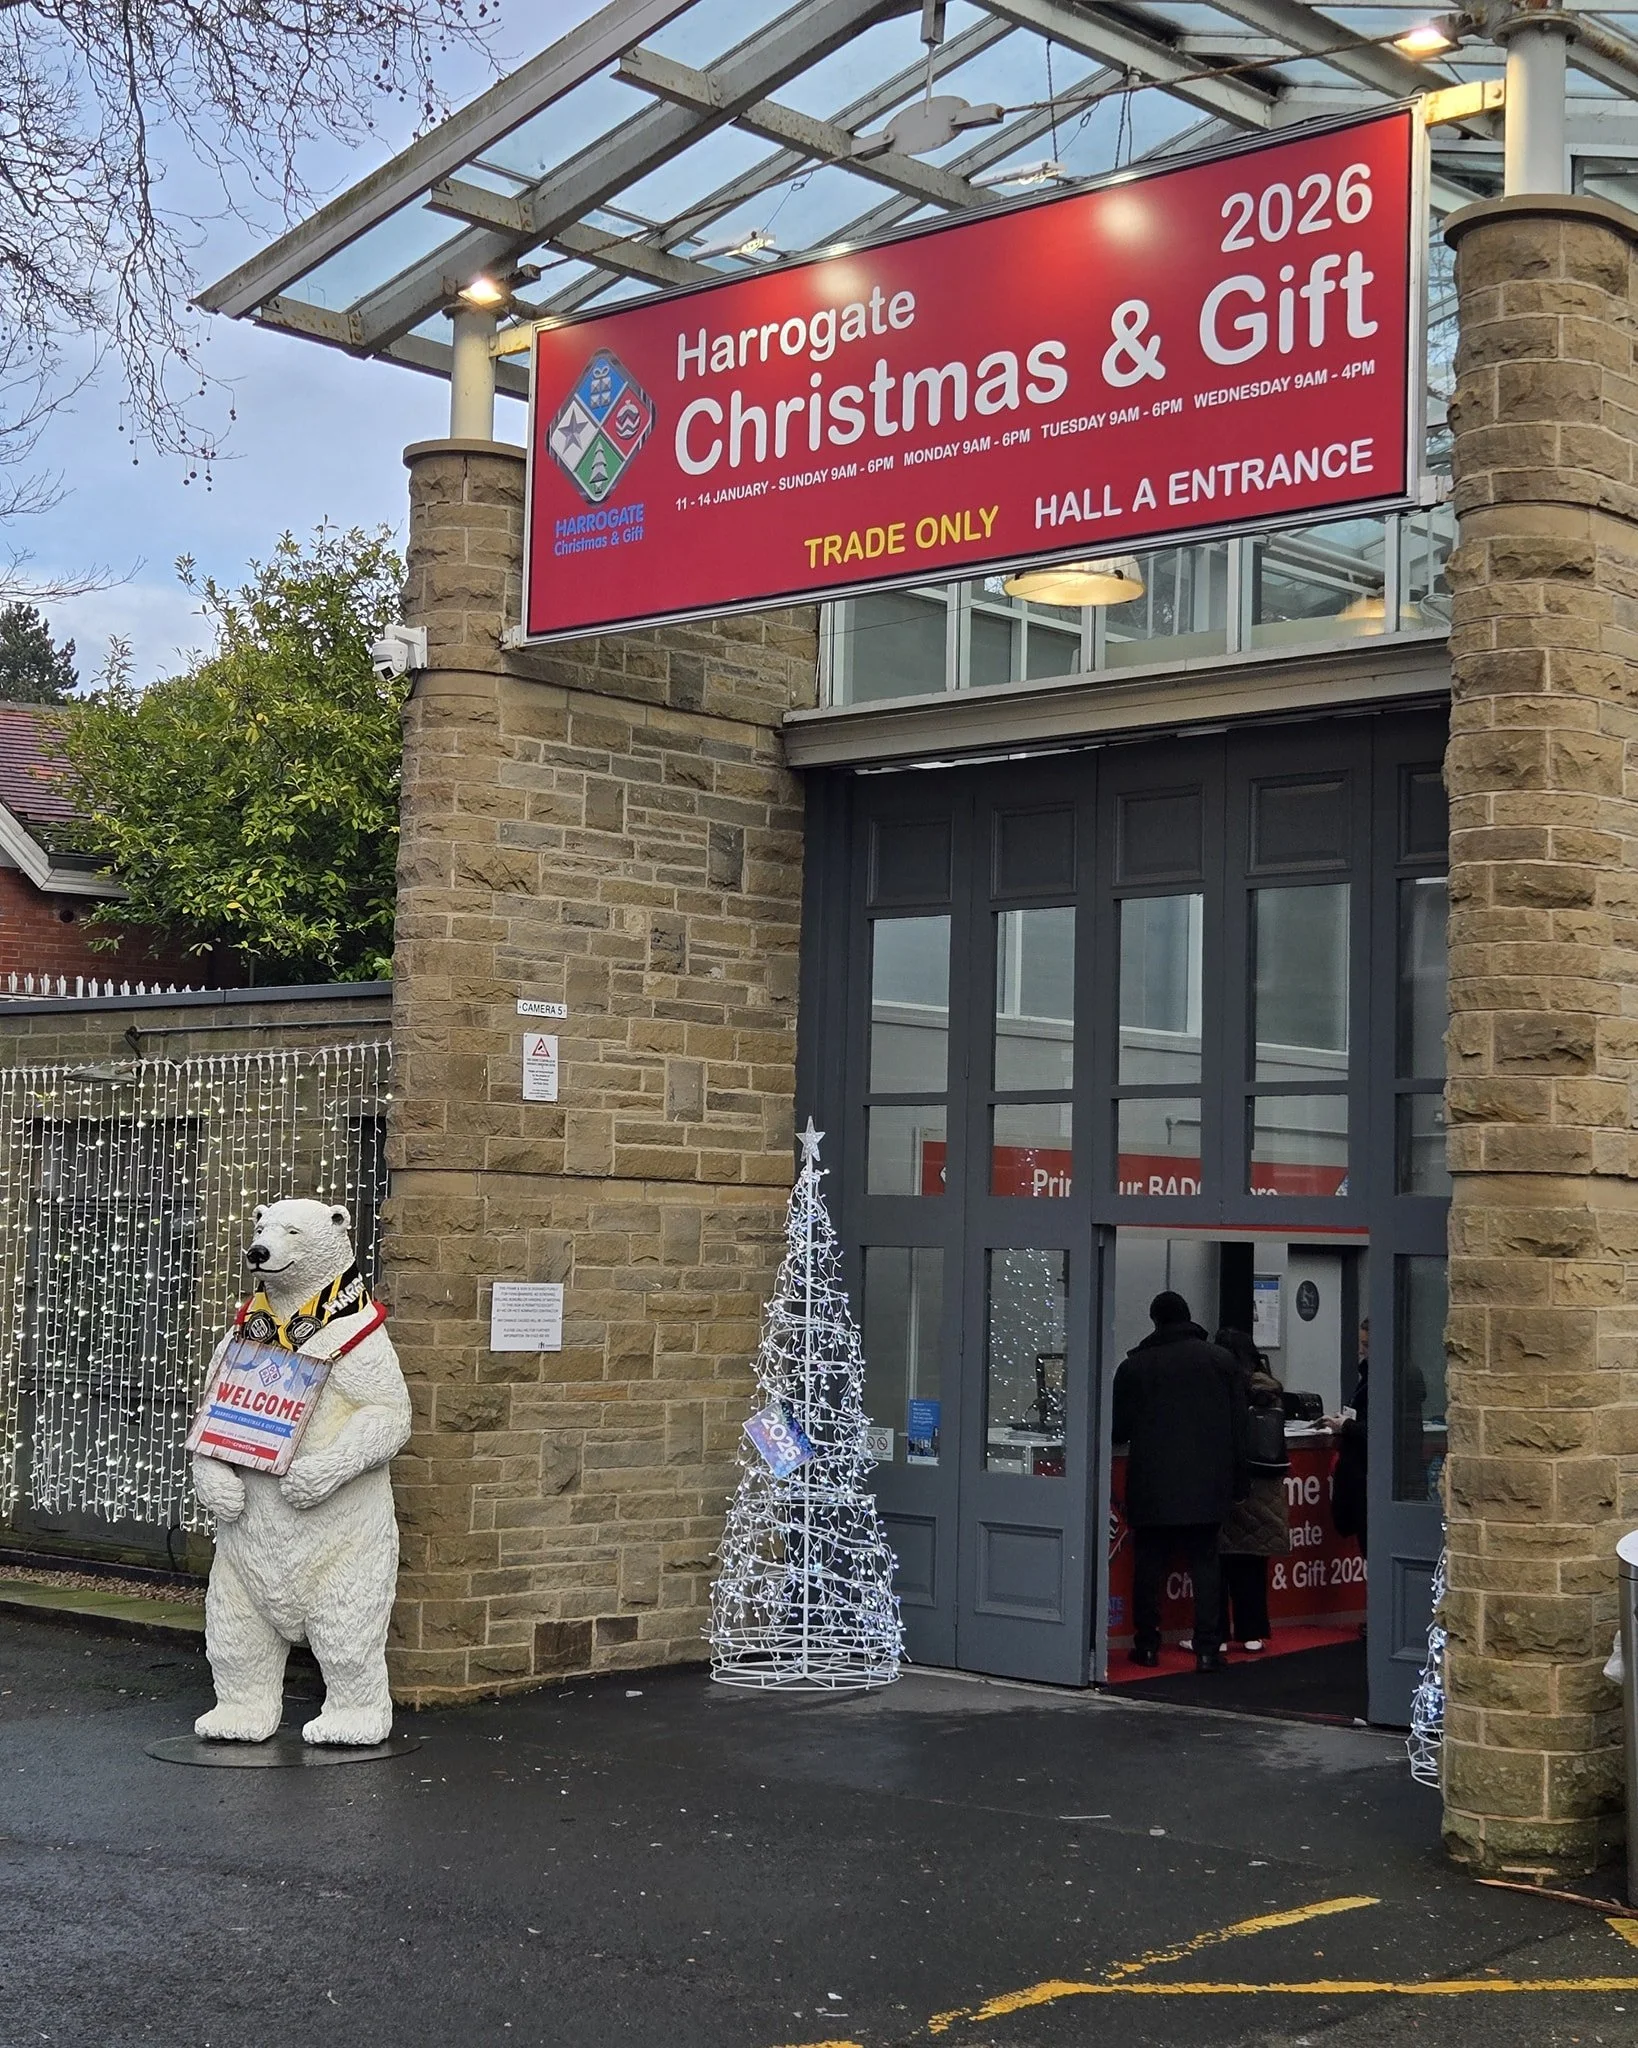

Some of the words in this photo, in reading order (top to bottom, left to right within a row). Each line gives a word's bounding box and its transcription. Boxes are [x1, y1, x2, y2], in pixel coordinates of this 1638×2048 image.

[1220, 163, 1373, 253] 2026
[677, 285, 916, 382] Harrogate
[675, 340, 1068, 476] Christmas
[1101, 299, 1166, 388] &
[1199, 250, 1379, 366] Gift
[675, 496, 687, 511] 11
[697, 492, 711, 507] 14
[712, 480, 769, 504] JANUARY
[778, 468, 829, 491] SUNDAY
[830, 462, 857, 481] 9AM
[867, 455, 894, 473] 6PM
[903, 441, 961, 466] MONDAY
[962, 435, 991, 455] 9AM
[1002, 428, 1031, 447] 6PM
[1040, 412, 1107, 439] TUESDAY
[1109, 406, 1140, 426] 9AM
[1151, 397, 1183, 417] 6PM
[1193, 375, 1291, 409] WEDNESDAY
[1294, 368, 1328, 389] 9AM
[1341, 359, 1375, 379] 4PM
[555, 503, 645, 538] HARROGATE
[804, 522, 905, 567] TRADE
[915, 505, 999, 549] ONLY
[1035, 484, 1123, 530] HALL
[1132, 477, 1157, 513] A
[1168, 437, 1374, 506] ENTRANCE
[554, 534, 607, 556] Christmas
[610, 531, 620, 546] &
[622, 525, 645, 543] Gift
[521, 1002, 556, 1015] CAMERA
[557, 1006, 563, 1015] 5
[1148, 1175, 1202, 1196] BAD
[215, 1381, 306, 1423] WELCOME
[760, 1411, 801, 1462] 2026
[1271, 1562, 1287, 1590] &
[1292, 1560, 1327, 1588] Gift
